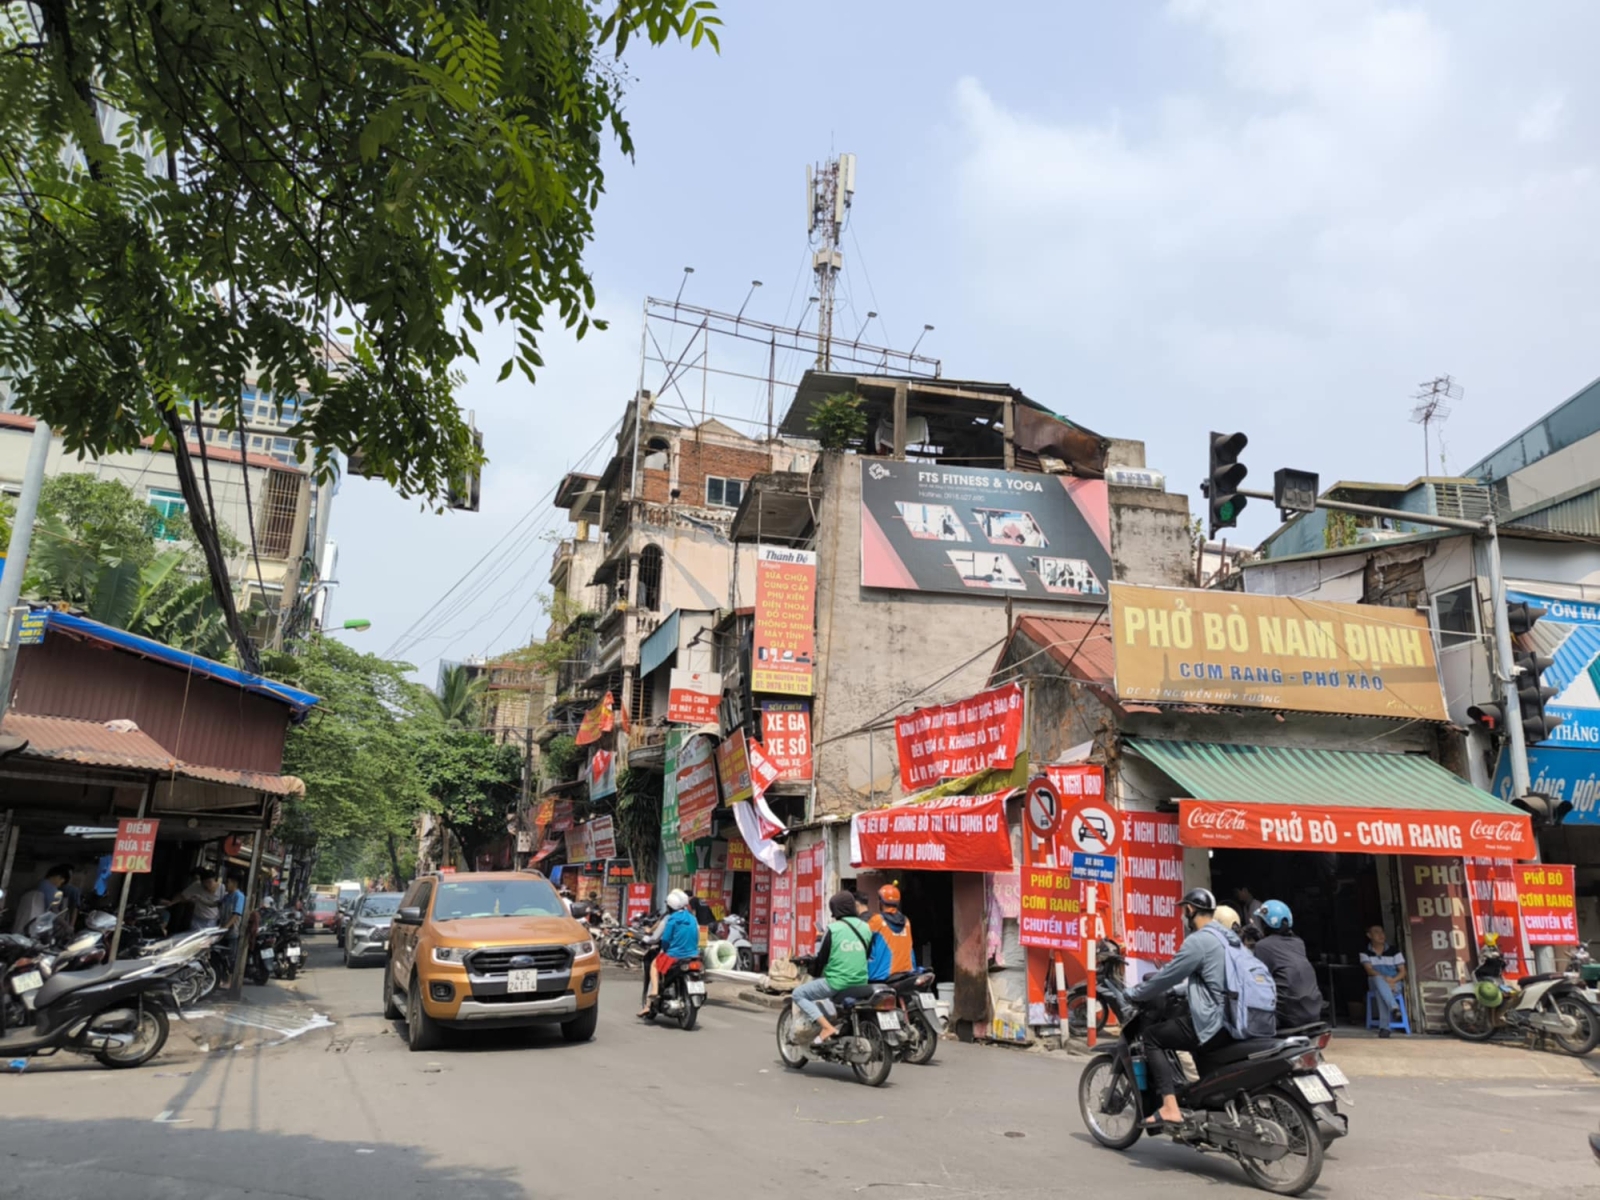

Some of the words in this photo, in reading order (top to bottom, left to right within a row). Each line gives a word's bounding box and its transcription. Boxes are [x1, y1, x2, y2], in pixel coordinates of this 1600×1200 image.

[918, 471, 939, 483] FTS
[942, 473, 990, 488] FITNESS
[993, 478, 1002, 488] &
[1006, 478, 1043, 493] YOGA
[1540, 600, 1578, 619] TÔN
[1123, 598, 1193, 650] PHỞ
[1202, 604, 1249, 653] BÒ
[1257, 615, 1337, 660] NAM
[1344, 622, 1426, 671] ĐỊNH
[1179, 662, 1223, 680] CƠM
[1231, 665, 1283, 684] RANG
[1302, 668, 1340, 688] PHỞ
[1346, 671, 1384, 691] XÀO
[767, 713, 785, 732] XE
[787, 713, 806, 732] GA
[767, 738, 785, 756] XE
[788, 730, 807, 756] SỐ
[960, 814, 983, 836] ĐỊNH
[1187, 806, 1249, 831] Coca-Cola
[1260, 810, 1303, 843] PHỞ
[1309, 814, 1338, 845] BÒ
[1357, 819, 1405, 847] CƠM
[1410, 823, 1463, 849] RANG
[1470, 818, 1525, 844] Coca-Cola
[116, 856, 148, 871] 10K
[1031, 871, 1052, 888] PHỞ
[1056, 874, 1070, 890] BÒ
[1523, 868, 1545, 885] PHỞ
[1548, 869, 1563, 886] BÒ
[1022, 895, 1046, 910] CƠM
[1050, 897, 1080, 913] RANG
[1153, 895, 1176, 917] NGAY
[1416, 893, 1465, 917] BÚN
[1519, 893, 1544, 907] CƠM
[1546, 894, 1573, 908] RANG
[1431, 925, 1467, 950] BÒ
[1435, 956, 1471, 981] GÀ
